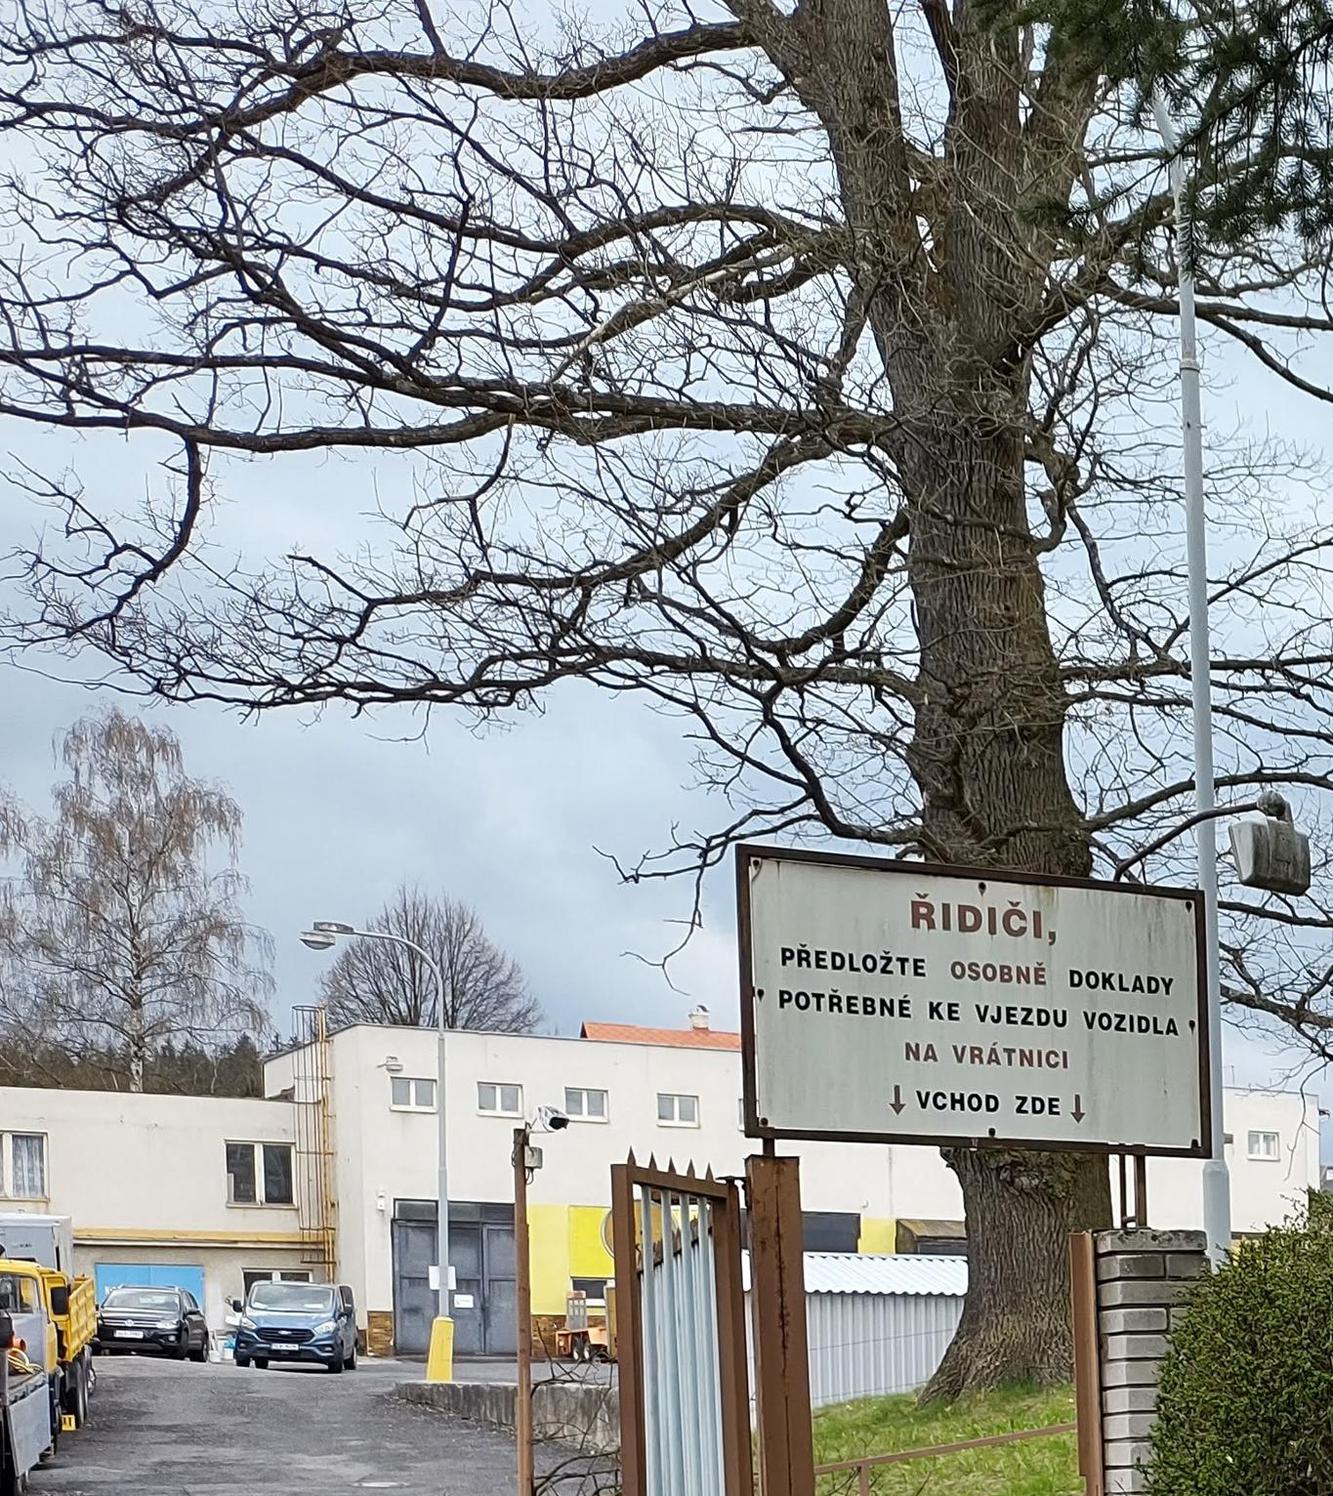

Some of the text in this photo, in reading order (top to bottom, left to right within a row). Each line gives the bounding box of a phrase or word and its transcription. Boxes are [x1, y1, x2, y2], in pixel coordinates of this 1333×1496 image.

[911, 893, 1057, 946] ŘIDIČI,
[781, 943, 1174, 995] PŘEDLOŽTE OSOBNĚ DOKLADY
[779, 988, 1179, 1036] POTŘEBNÉ KE VJEZDU VOZIDLA
[905, 1042, 1069, 1069] NA VRÁTNICI
[916, 1091, 1061, 1115] VCHOD ZDE
